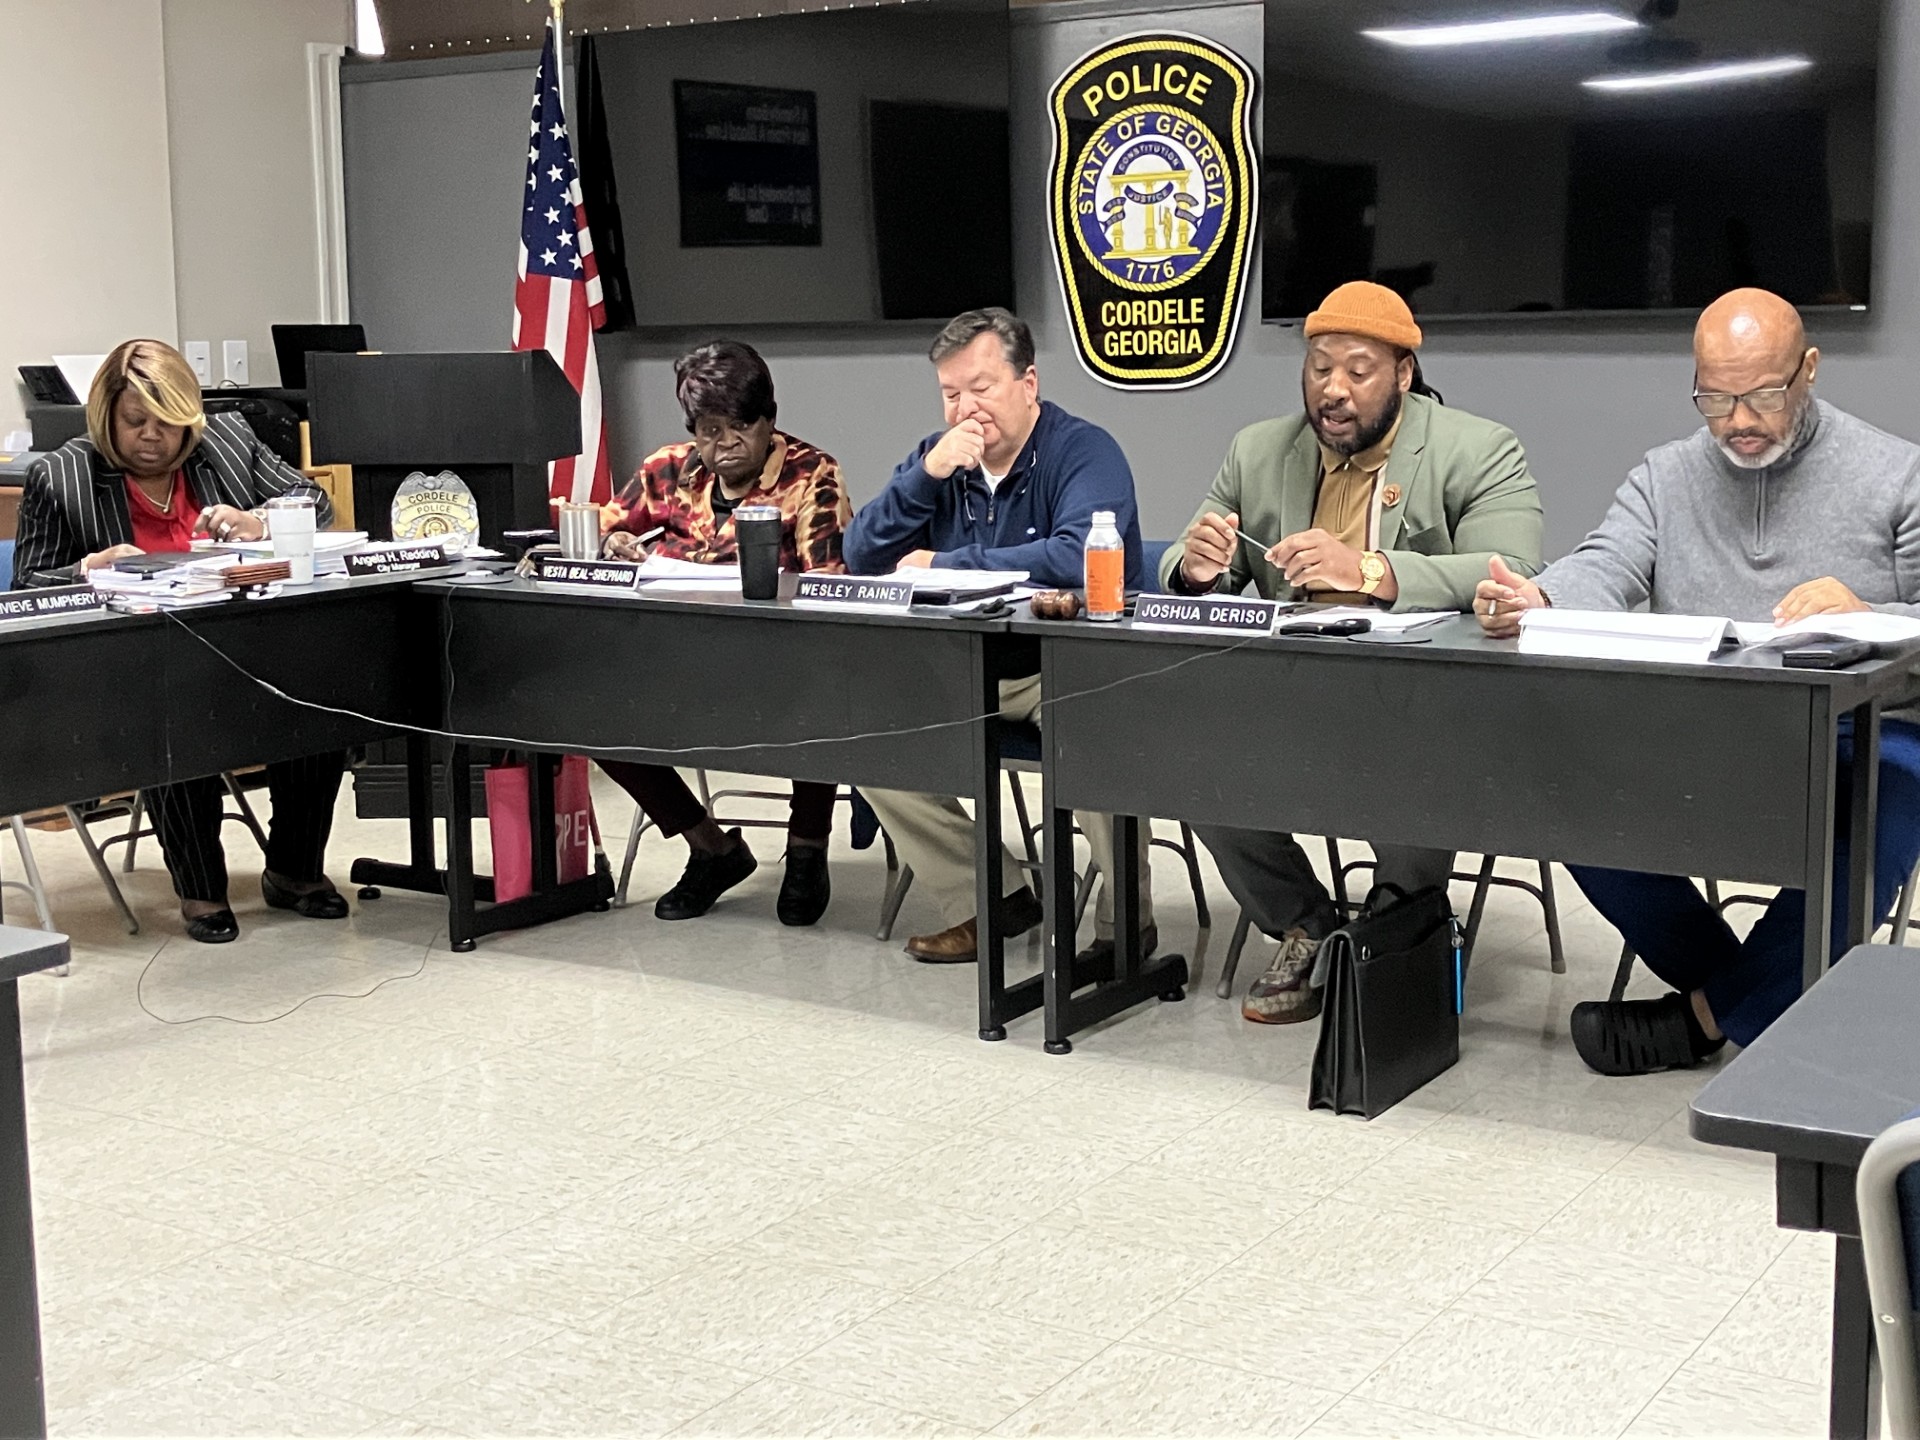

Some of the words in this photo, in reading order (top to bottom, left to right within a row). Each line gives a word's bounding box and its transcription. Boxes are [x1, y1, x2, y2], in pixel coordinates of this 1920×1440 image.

[1082, 63, 1212, 116] POLICE
[1079, 138, 1113, 214] STATE
[1117, 115, 1146, 140] OF
[1156, 115, 1224, 209] GEORGIA
[1118, 144, 1180, 171] CONSTITUTION
[1128, 189, 1169, 202] JUSTICE
[1126, 261, 1175, 282] 1776
[1101, 298, 1205, 327] CORDELE
[1104, 328, 1203, 356] GEORGIA
[408, 491, 458, 503] CORDELE
[417, 504, 451, 514] POLICE
[352, 553, 386, 567] Angela
[386, 551, 400, 562] H.
[400, 548, 440, 560] Redding
[543, 566, 567, 578] VESTA
[36, 593, 96, 609] MUMPHERY
[801, 583, 853, 598] WESLEY
[858, 586, 907, 600] RAINEY
[1141, 604, 1200, 620] JOSHUA
[1209, 608, 1267, 624] DERISO
